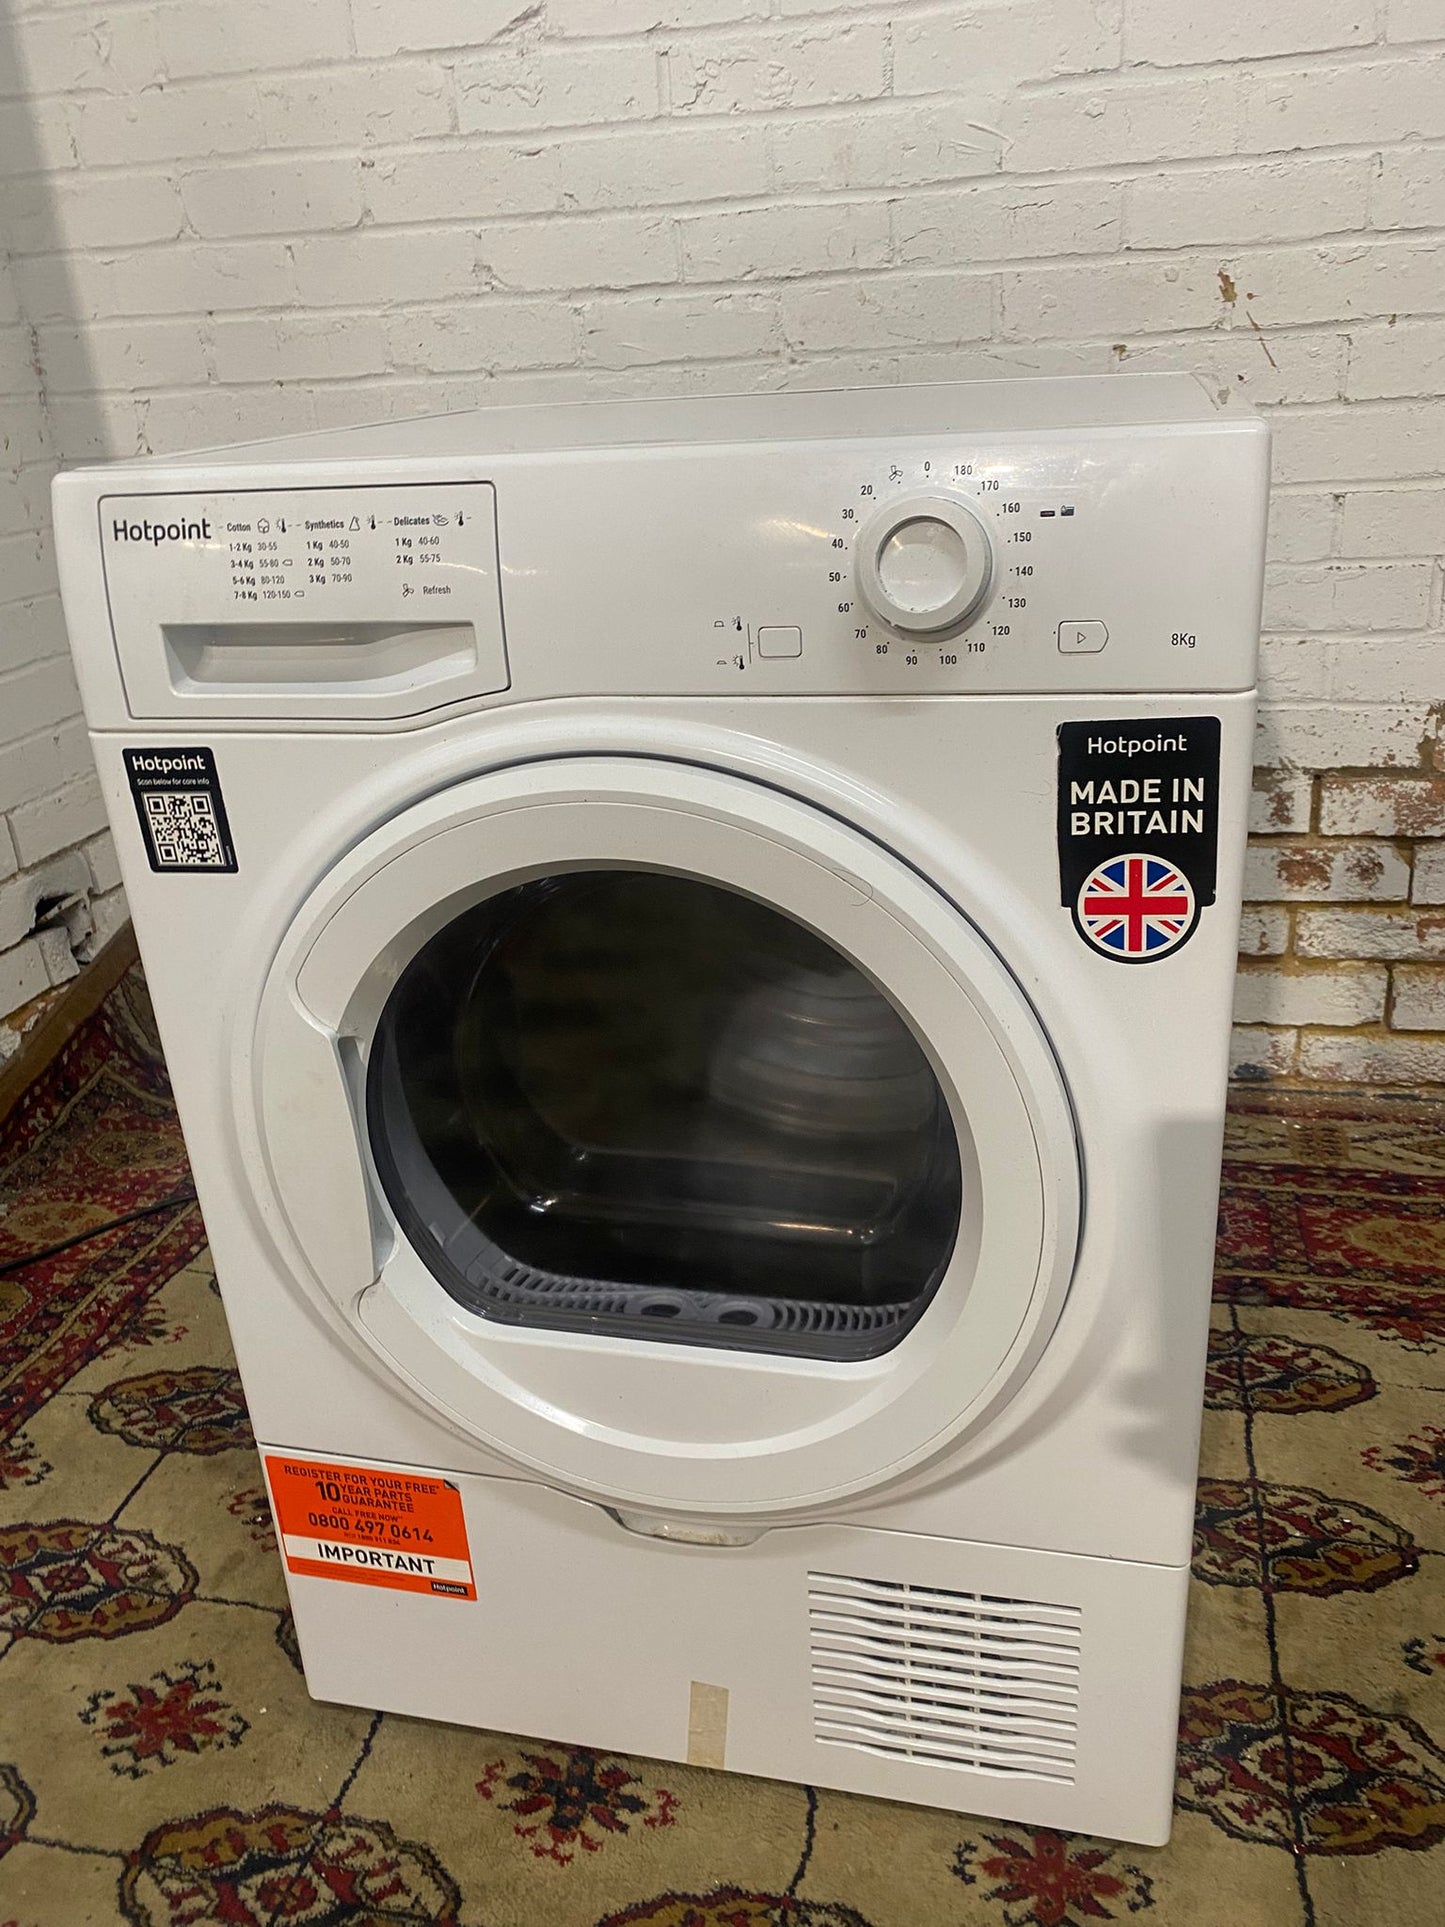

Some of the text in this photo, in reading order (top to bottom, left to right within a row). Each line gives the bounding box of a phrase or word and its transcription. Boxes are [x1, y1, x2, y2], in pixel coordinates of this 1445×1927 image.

[924, 461, 931, 472] 0
[955, 465, 973, 475] 180
[860, 484, 873, 496] 20
[981, 480, 999, 491] 170
[842, 508, 854, 519] 30
[1002, 503, 1021, 513] 160
[226, 521, 251, 532] Cotton
[305, 519, 344, 531] Synthetics
[394, 516, 430, 526] Delicates
[113, 517, 211, 547] Hotpoint
[1013, 532, 1032, 542] 150
[242, 542, 252, 553] Kg
[257, 541, 278, 551] 30-55
[313, 540, 323, 551] Kg
[329, 539, 350, 549] 40-50
[401, 537, 412, 548] Kg
[418, 536, 440, 546] 40-60
[831, 538, 844, 549] 40
[243, 559, 254, 570] Kg
[259, 558, 279, 568] 55-80
[314, 557, 324, 568] Kg
[330, 556, 351, 566] 50-70
[403, 554, 414, 565] Kg
[420, 553, 441, 563] 55-75
[828, 572, 841, 582] 50
[1015, 566, 1034, 576] 140
[245, 576, 256, 587] Kg
[260, 574, 285, 585] 80-120
[315, 574, 326, 585] Kg
[331, 573, 353, 583] 70-90
[247, 590, 258, 601] Kg
[262, 589, 291, 599] 120-150
[422, 585, 451, 595] Refresh
[838, 602, 850, 613] 60
[1008, 598, 1027, 608] 130
[854, 628, 867, 639] 70
[992, 625, 1010, 636] 120
[1171, 632, 1196, 649] 8Kg
[876, 644, 888, 655] 80
[967, 642, 986, 652] 110
[905, 655, 918, 665] 90
[939, 655, 957, 665] 100
[1088, 733, 1188, 758] Hotpoint
[132, 754, 206, 774] Hotpoint
[1070, 777, 1205, 805] MADE IN
[1070, 809, 1204, 836] BRITAIN
[284, 1464, 341, 1482] REGISTER
[344, 1473, 367, 1486] FOR
[370, 1476, 402, 1491] YOUR
[315, 1480, 341, 1502] 10
[340, 1483, 413, 1503] YEAR PARTS
[342, 1494, 414, 1513] GUARANTEE
[332, 1506, 352, 1517] CALL
[354, 1509, 377, 1520] FREE
[308, 1512, 350, 1531] 0800
[354, 1519, 385, 1536] 497
[390, 1524, 434, 1543] 0614
[317, 1543, 435, 1574] IMPORTANT
[433, 1583, 466, 1594] Hotpoint
